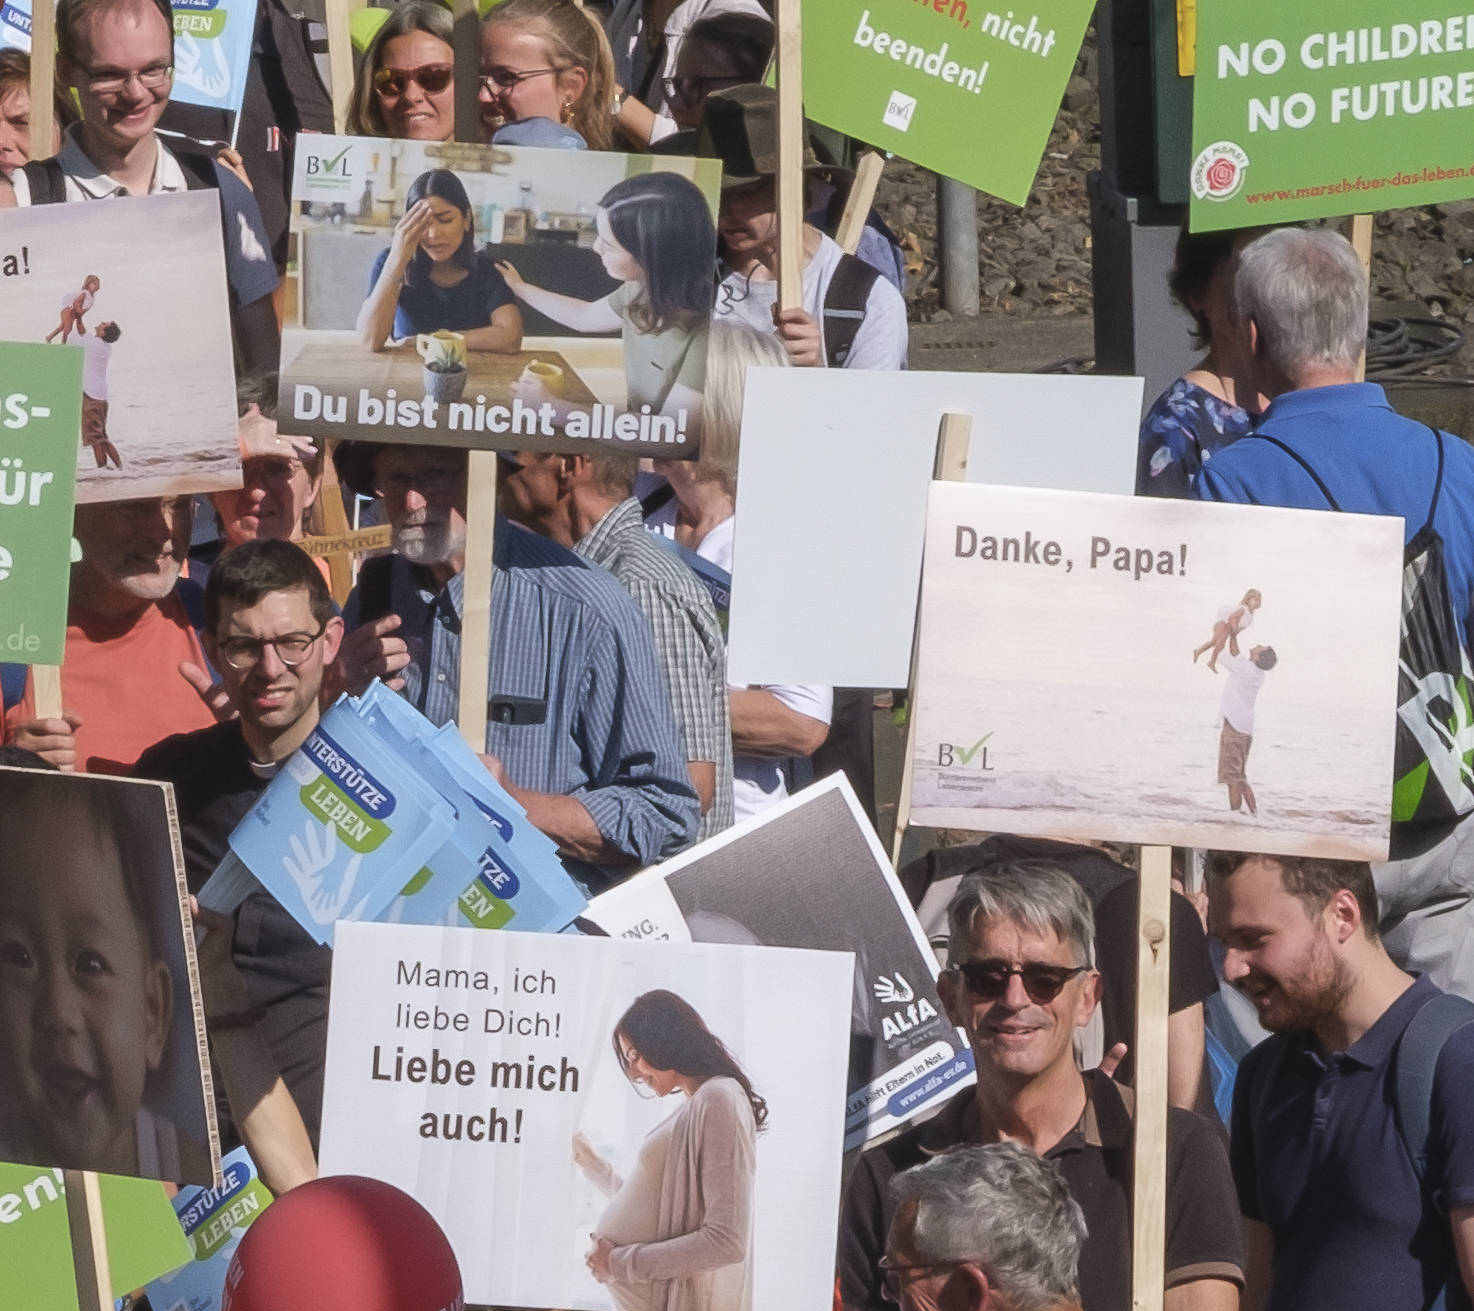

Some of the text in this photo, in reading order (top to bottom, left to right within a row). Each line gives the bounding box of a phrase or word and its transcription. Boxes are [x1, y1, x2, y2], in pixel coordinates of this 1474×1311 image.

[854, 12, 989, 95] beenden!
[980, 11, 1056, 58] nicht
[1218, 39, 1285, 79] NO
[1248, 70, 1474, 132] NO FUTURE
[955, 525, 1188, 581] Danke, Papa!
